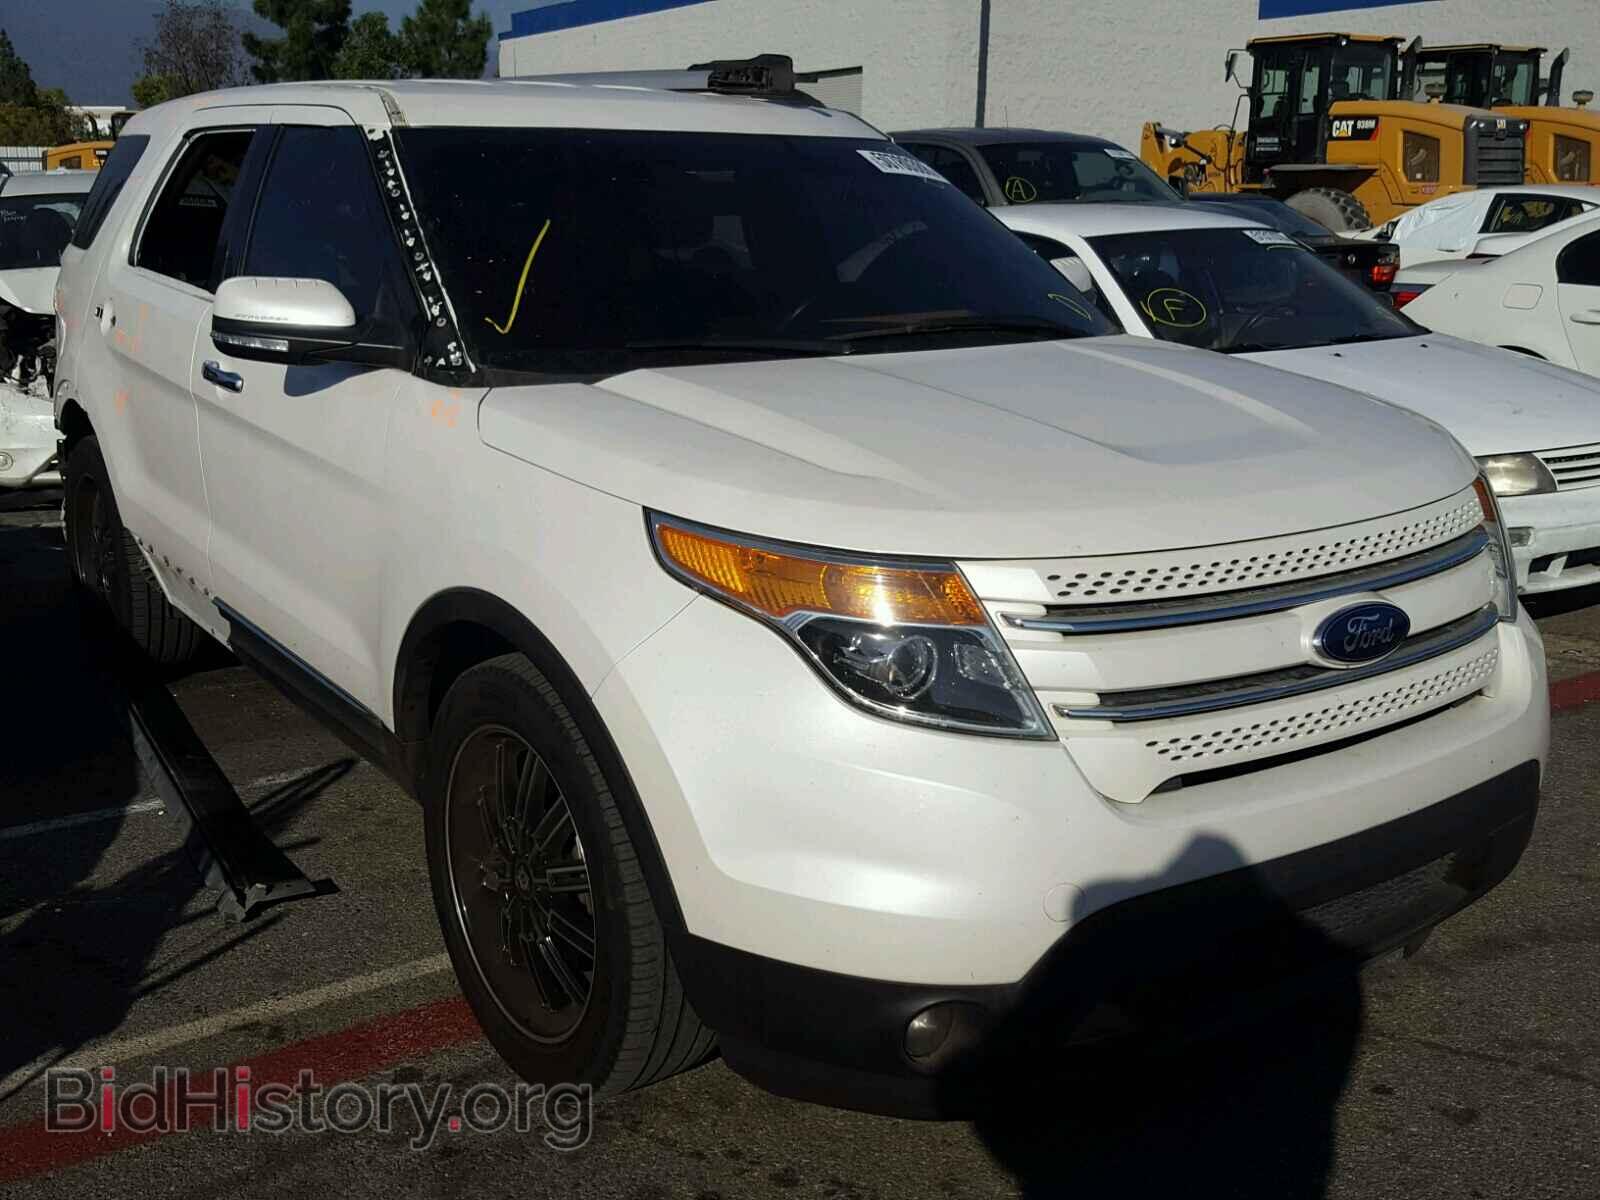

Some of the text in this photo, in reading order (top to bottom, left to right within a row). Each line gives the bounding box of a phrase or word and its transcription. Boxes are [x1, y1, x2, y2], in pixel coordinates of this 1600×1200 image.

[1332, 120, 1354, 137] CAT
[1164, 299, 1184, 320] F
[1343, 613, 1393, 652] Ford
